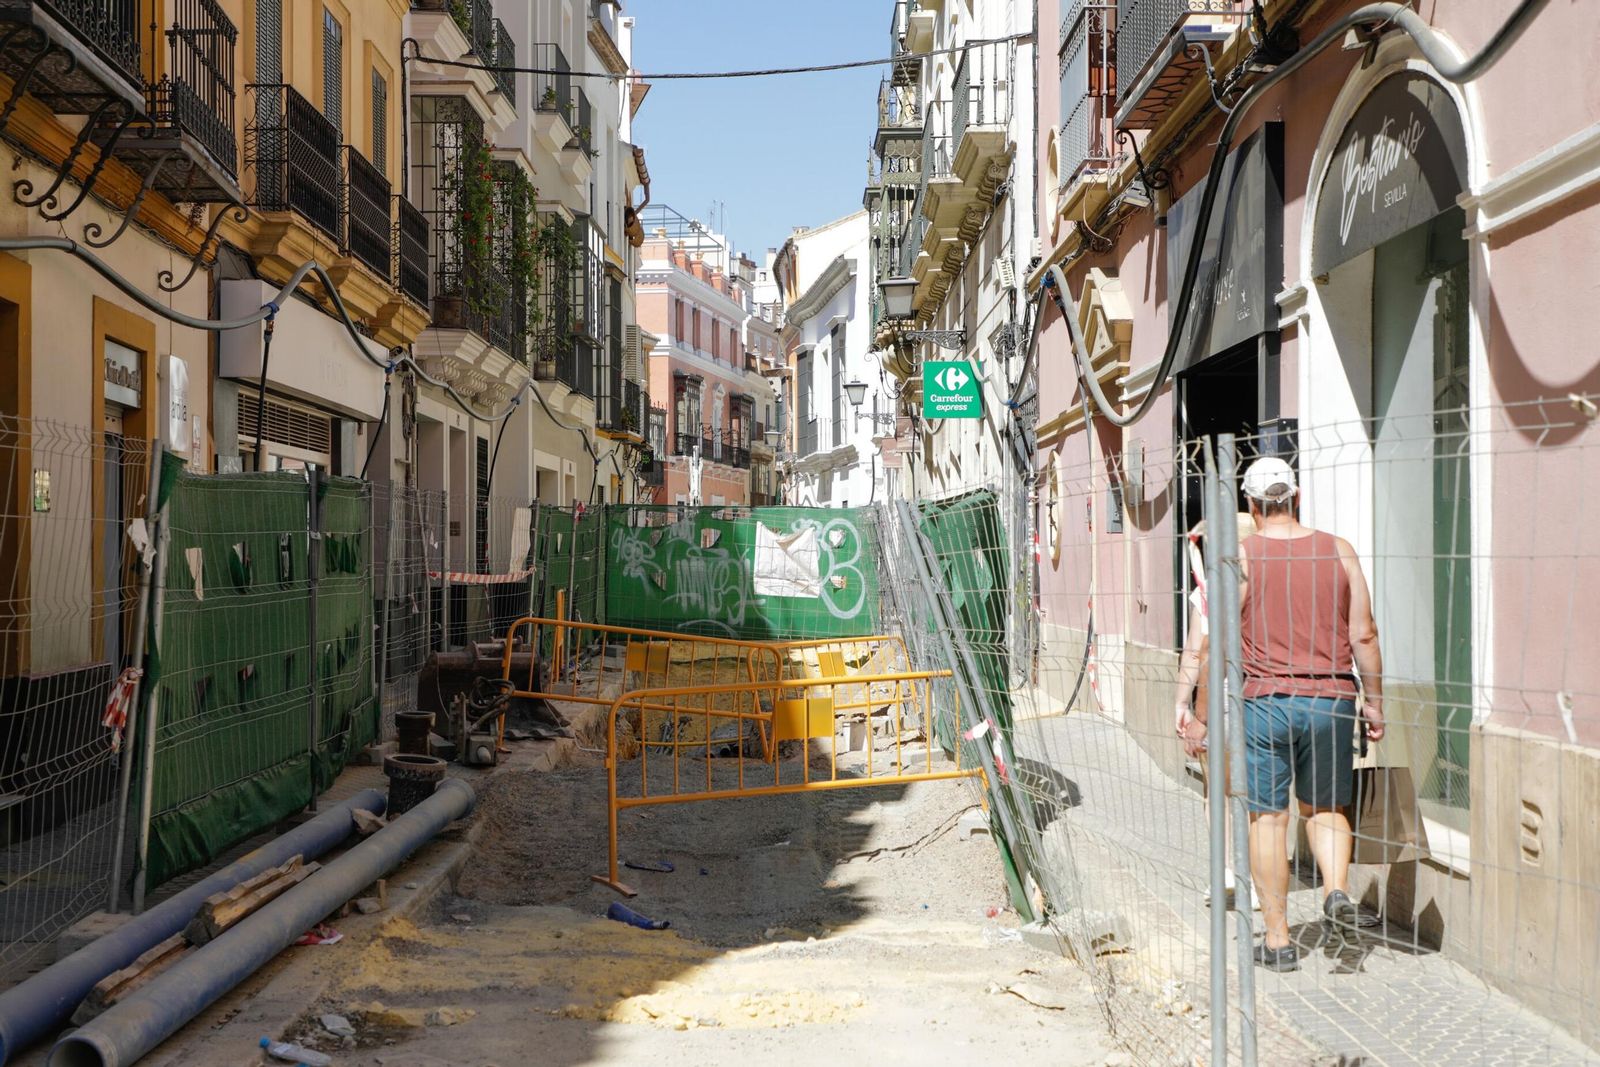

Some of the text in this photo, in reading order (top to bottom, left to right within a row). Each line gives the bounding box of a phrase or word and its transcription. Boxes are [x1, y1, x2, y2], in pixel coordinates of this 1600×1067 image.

[1340, 112, 1425, 246] Bestiario
[1384, 183, 1408, 208] SEVILLA
[930, 394, 973, 403] Carrefour
[936, 404, 967, 412] express
